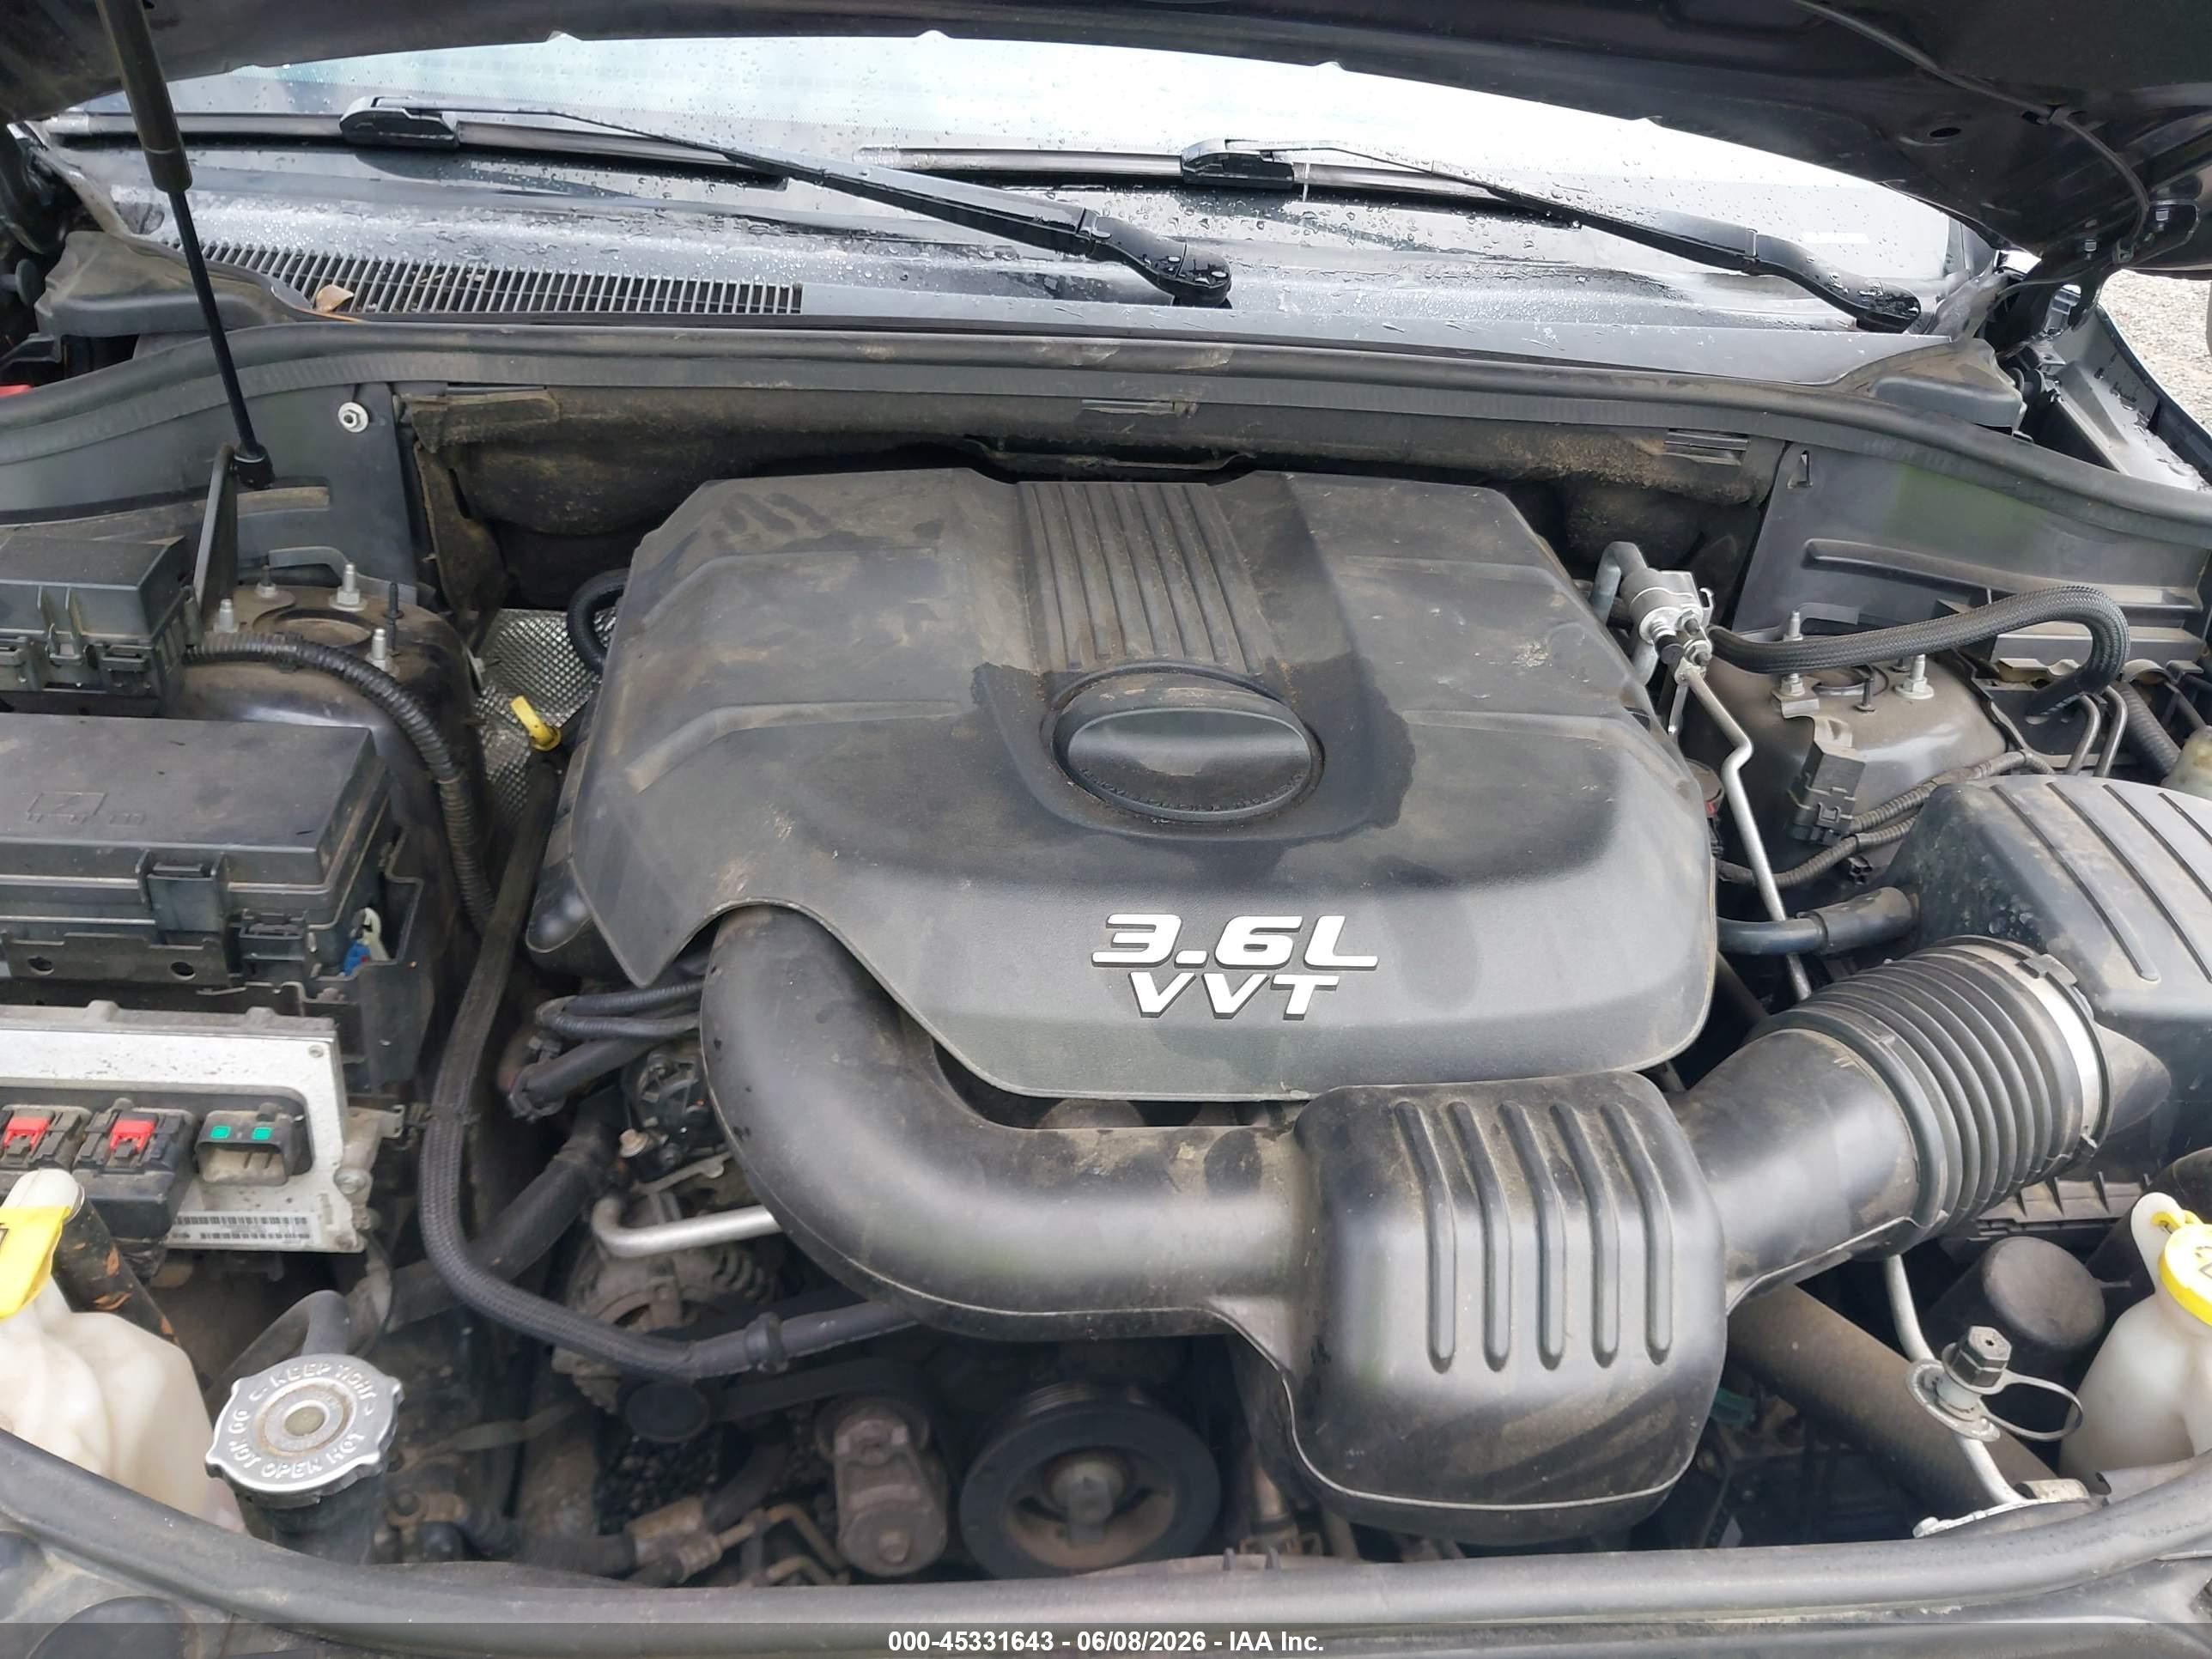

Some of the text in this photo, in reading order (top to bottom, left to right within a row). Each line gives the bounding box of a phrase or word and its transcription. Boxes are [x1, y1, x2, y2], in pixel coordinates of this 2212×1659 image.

[1091, 913, 1380, 970] 3.6L
[1128, 971, 1340, 1021] VVT
[270, 1362, 331, 1387] KEEP
[228, 1409, 251, 1434] DO
[229, 1437, 260, 1468] NOT
[325, 1433, 365, 1464] HOT
[262, 1459, 323, 1480] OPEN
